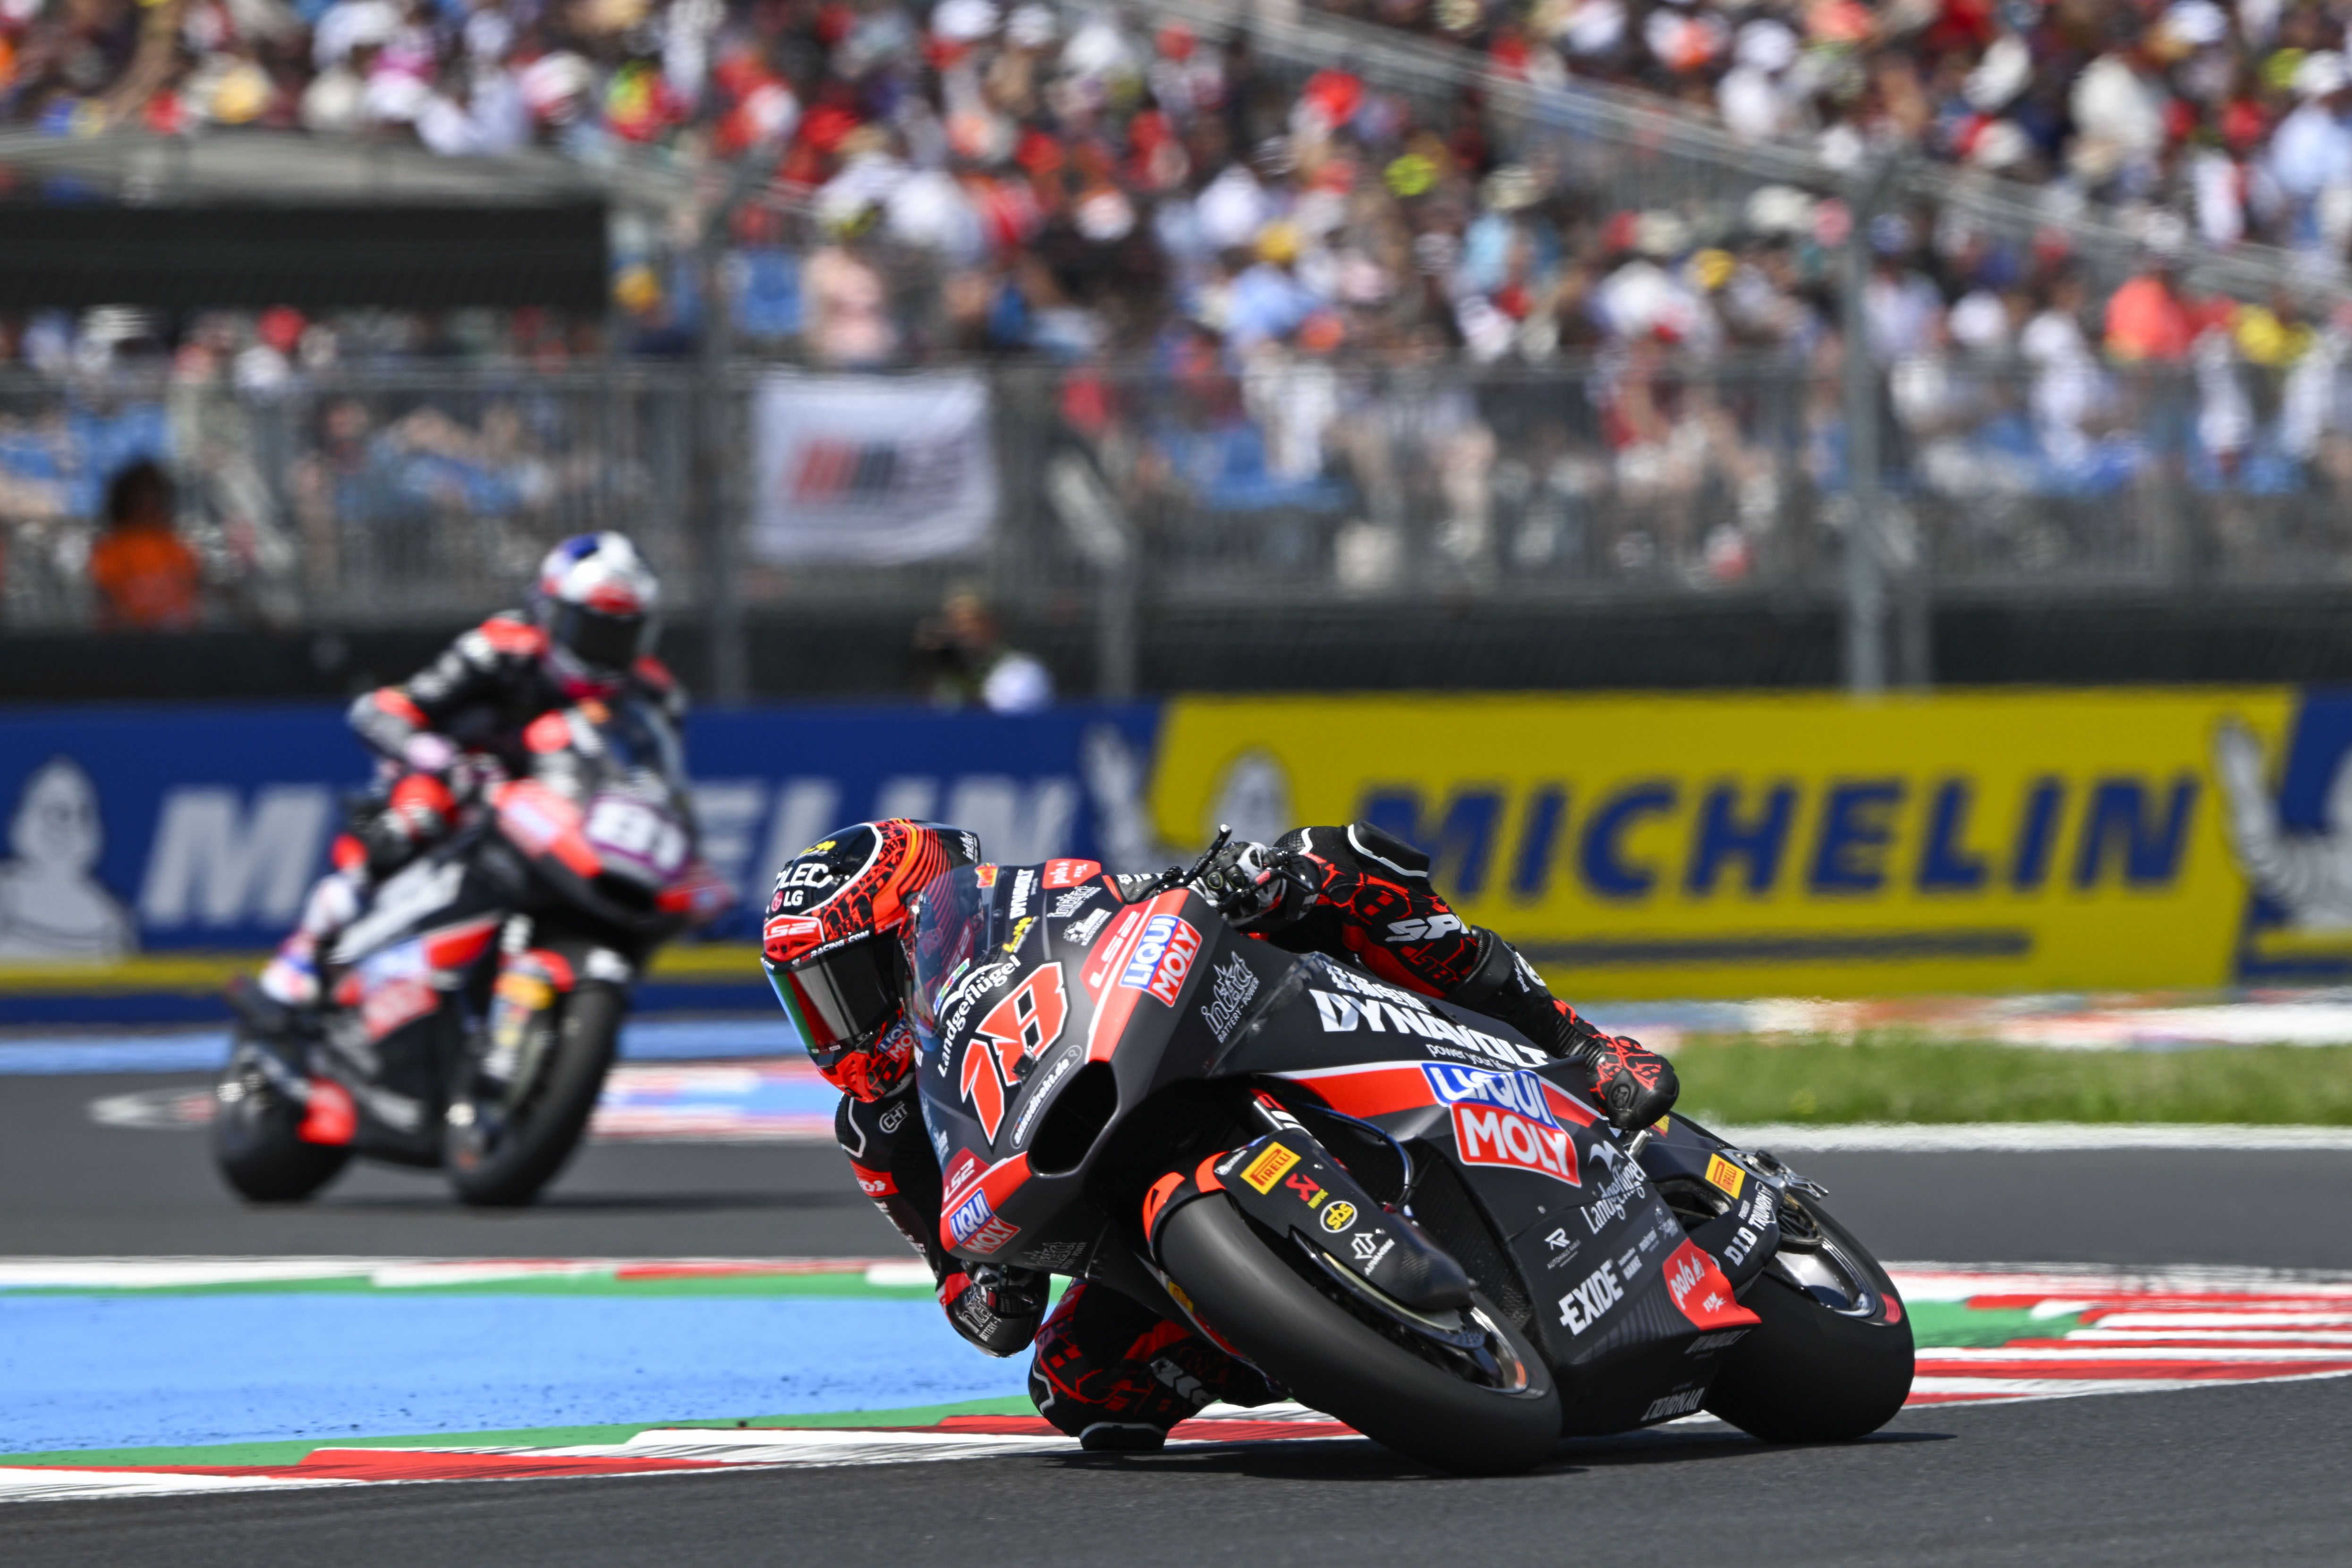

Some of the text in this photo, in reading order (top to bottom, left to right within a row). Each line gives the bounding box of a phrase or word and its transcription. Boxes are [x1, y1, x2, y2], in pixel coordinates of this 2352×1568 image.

[1354, 771, 2203, 902] MICHELIN
[783, 890, 804, 907] LG
[1050, 866, 1070, 884] polo
[764, 921, 818, 941] LS2
[1089, 911, 1141, 988] LS2
[1123, 918, 1176, 985] LIQUI
[1152, 923, 1197, 1001] MOLY
[879, 1016, 910, 1051] LIQU
[938, 954, 1021, 1077] Landgeflügel
[1217, 1008, 1242, 1043] BATTERY
[1241, 976, 1260, 1006] POWER
[1309, 989, 1548, 1067] DYNAVOLT
[960, 962, 1068, 1145] 18
[1425, 1043, 1467, 1059] power
[1429, 1067, 1553, 1126] LIQUI
[1249, 1148, 1292, 1187] PIRELLI
[1460, 1108, 1570, 1177] MOLY
[944, 1158, 975, 1203] LS2
[1580, 1150, 1647, 1235] Landgeflügel
[1713, 1160, 1737, 1193] PIRELLI
[951, 1193, 991, 1242] LIQUI
[965, 1218, 1014, 1254] MOLY
[1327, 1203, 1354, 1230] sbs
[1748, 1191, 1773, 1231] TRIUMPH
[1558, 1259, 1624, 1336] EXIDE
[1670, 1259, 1697, 1311] polo
[1702, 1292, 1718, 1313] FLM
